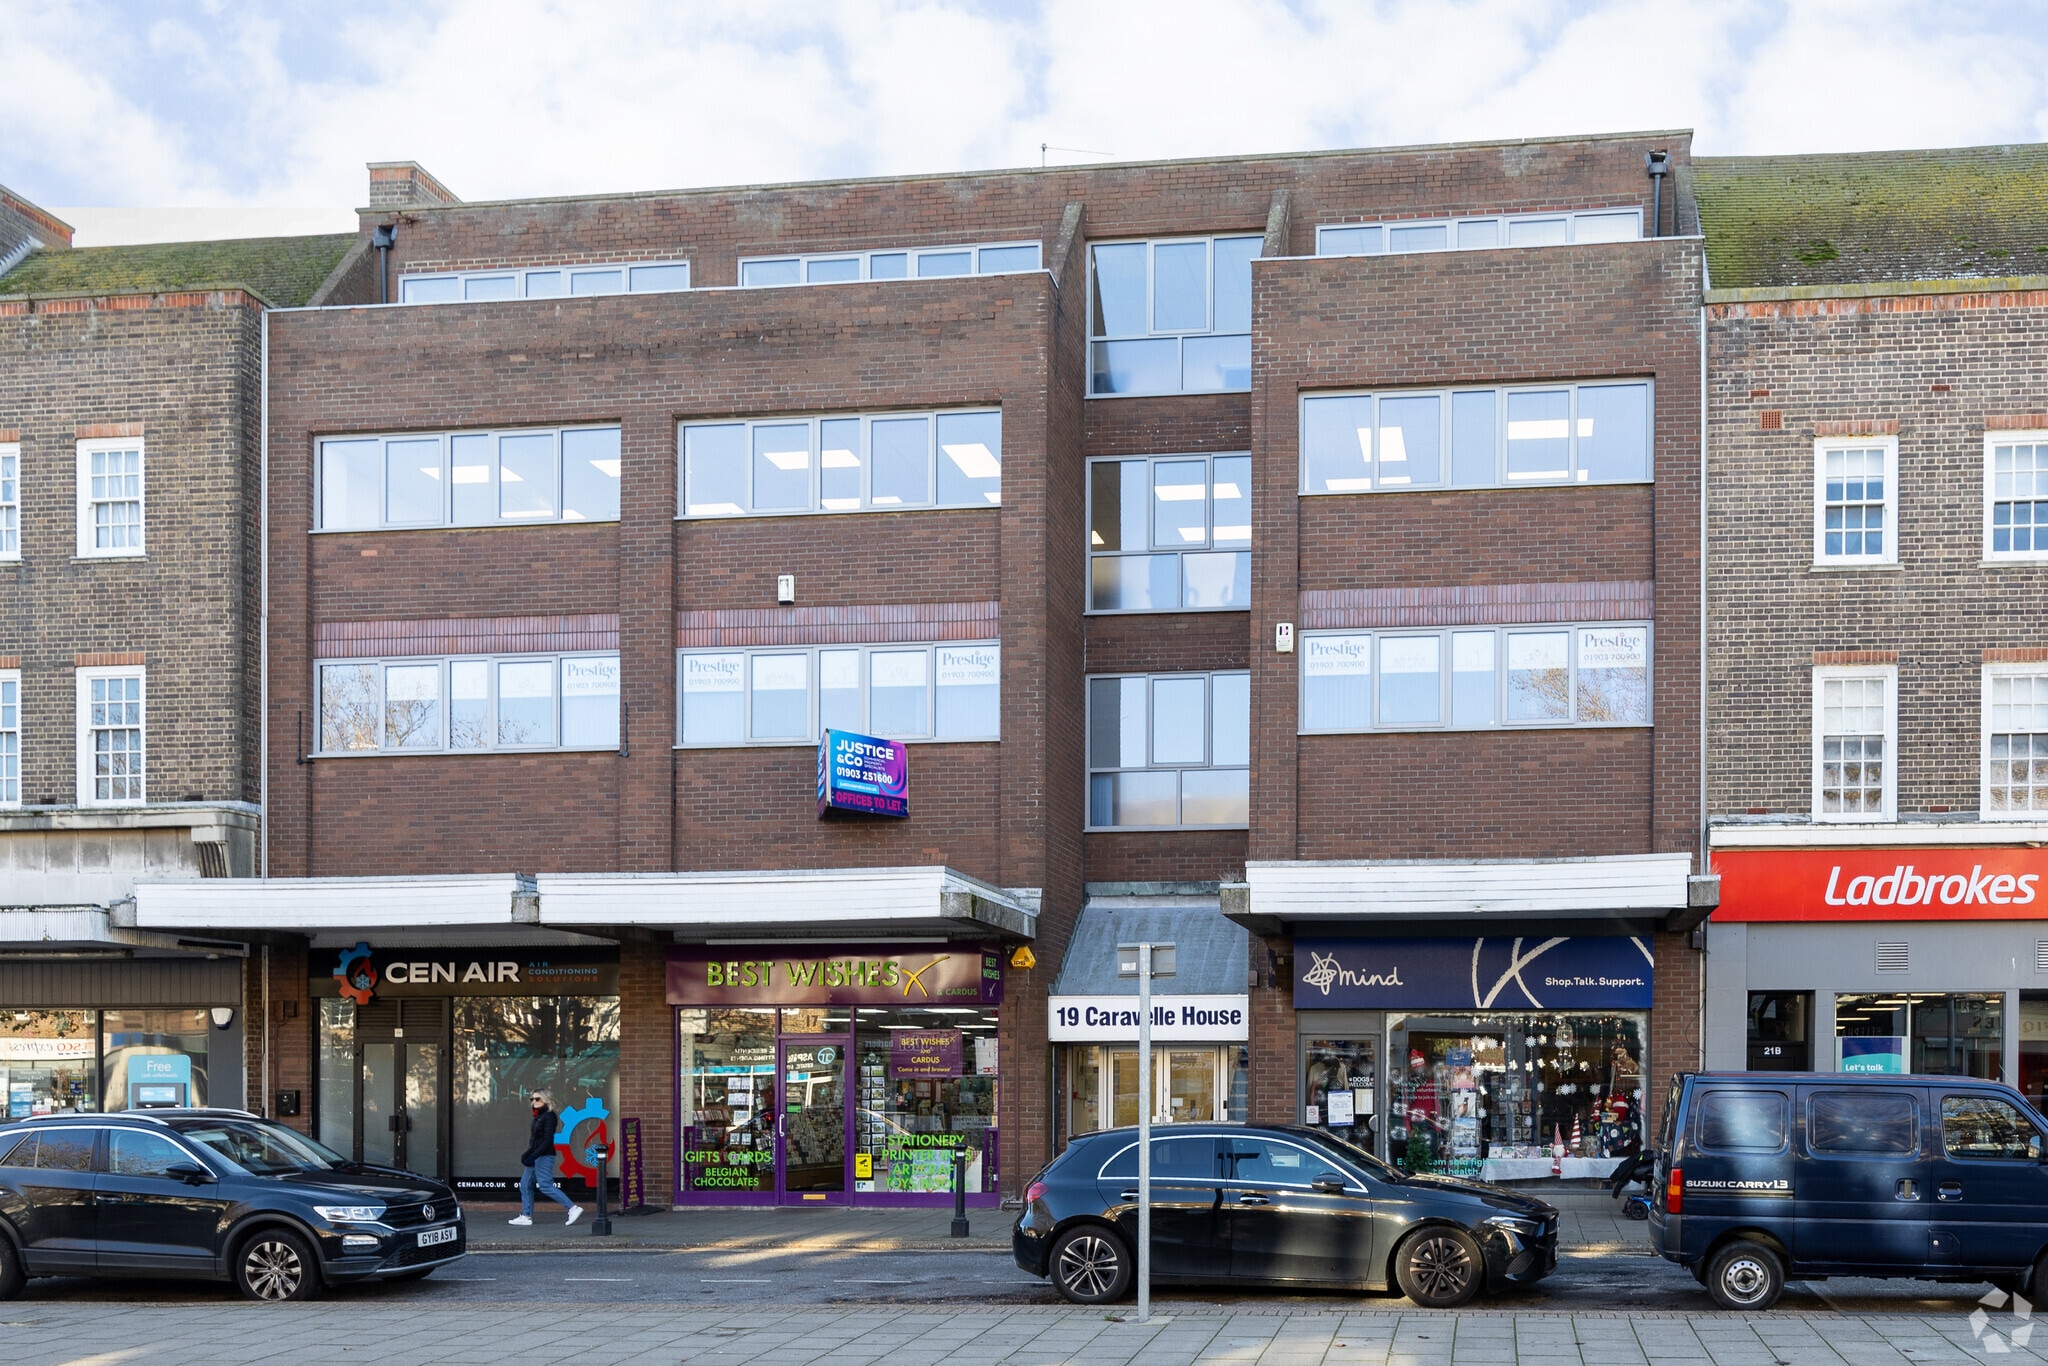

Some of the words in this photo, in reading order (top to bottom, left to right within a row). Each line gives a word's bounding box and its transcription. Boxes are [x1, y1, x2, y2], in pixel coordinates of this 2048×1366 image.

[1584, 632, 1640, 651] Prestige
[1310, 640, 1365, 658] Prestige
[943, 650, 995, 668] Prestige
[1310, 661, 1334, 669] 01903
[1336, 660, 1365, 668] 700900
[567, 661, 617, 679] Prestige
[689, 658, 740, 676] Prestige
[942, 671, 965, 679] 01903
[967, 670, 995, 678] 700900
[567, 682, 589, 690] 01903
[591, 680, 617, 689] 700900
[688, 678, 711, 686] 01903
[713, 677, 740, 685] 700900
[836, 739, 895, 761] JUSTICE
[836, 753, 863, 767] &Co
[836, 766, 861, 779] 01903
[862, 771, 893, 784] 251600
[836, 791, 873, 807] OFFICES
[873, 796, 885, 809] TO
[887, 799, 902, 811] LET
[1824, 864, 2040, 906] Ladbrokes
[985, 956, 997, 967] BEST
[385, 962, 455, 983] CEN
[462, 961, 521, 983] AIR
[707, 961, 775, 987] BEST
[784, 960, 900, 987] WISHES
[982, 967, 1000, 980] WISHES
[1339, 966, 1404, 987] mind
[528, 975, 598, 983] SOLUTIONS
[945, 988, 978, 996] CARDUS
[806, 1014, 818, 1027] 17
[1056, 1006, 1079, 1027] 19
[1085, 1006, 1176, 1027] Caravlle
[1182, 1005, 1242, 1026] House
[901, 1037, 919, 1046] BEST
[921, 1037, 951, 1046] WISHES
[1764, 1046, 1782, 1055] 21B
[146, 1060, 172, 1072] Free
[911, 1056, 940, 1064] CARDUS
[1845, 1064, 1866, 1072] Let's
[1866, 1064, 1884, 1072] talk
[887, 1134, 965, 1147] STATIONERY
[685, 1150, 720, 1163] GIFTS
[727, 1150, 771, 1163] CARDS
[881, 1148, 936, 1161] PRINTER
[940, 1148, 973, 1162] INS
[705, 1167, 748, 1177] BELGIAN
[1448, 1166, 1481, 1175] health.
[694, 1177, 760, 1187] CHOCOLATES
[885, 1177, 968, 1190] TOYS/BOO
[1686, 1180, 1726, 1188] SUZUKI
[1727, 1180, 1773, 1189] CARRY
[422, 1231, 439, 1245] GY18
[440, 1229, 453, 1241] ASV
